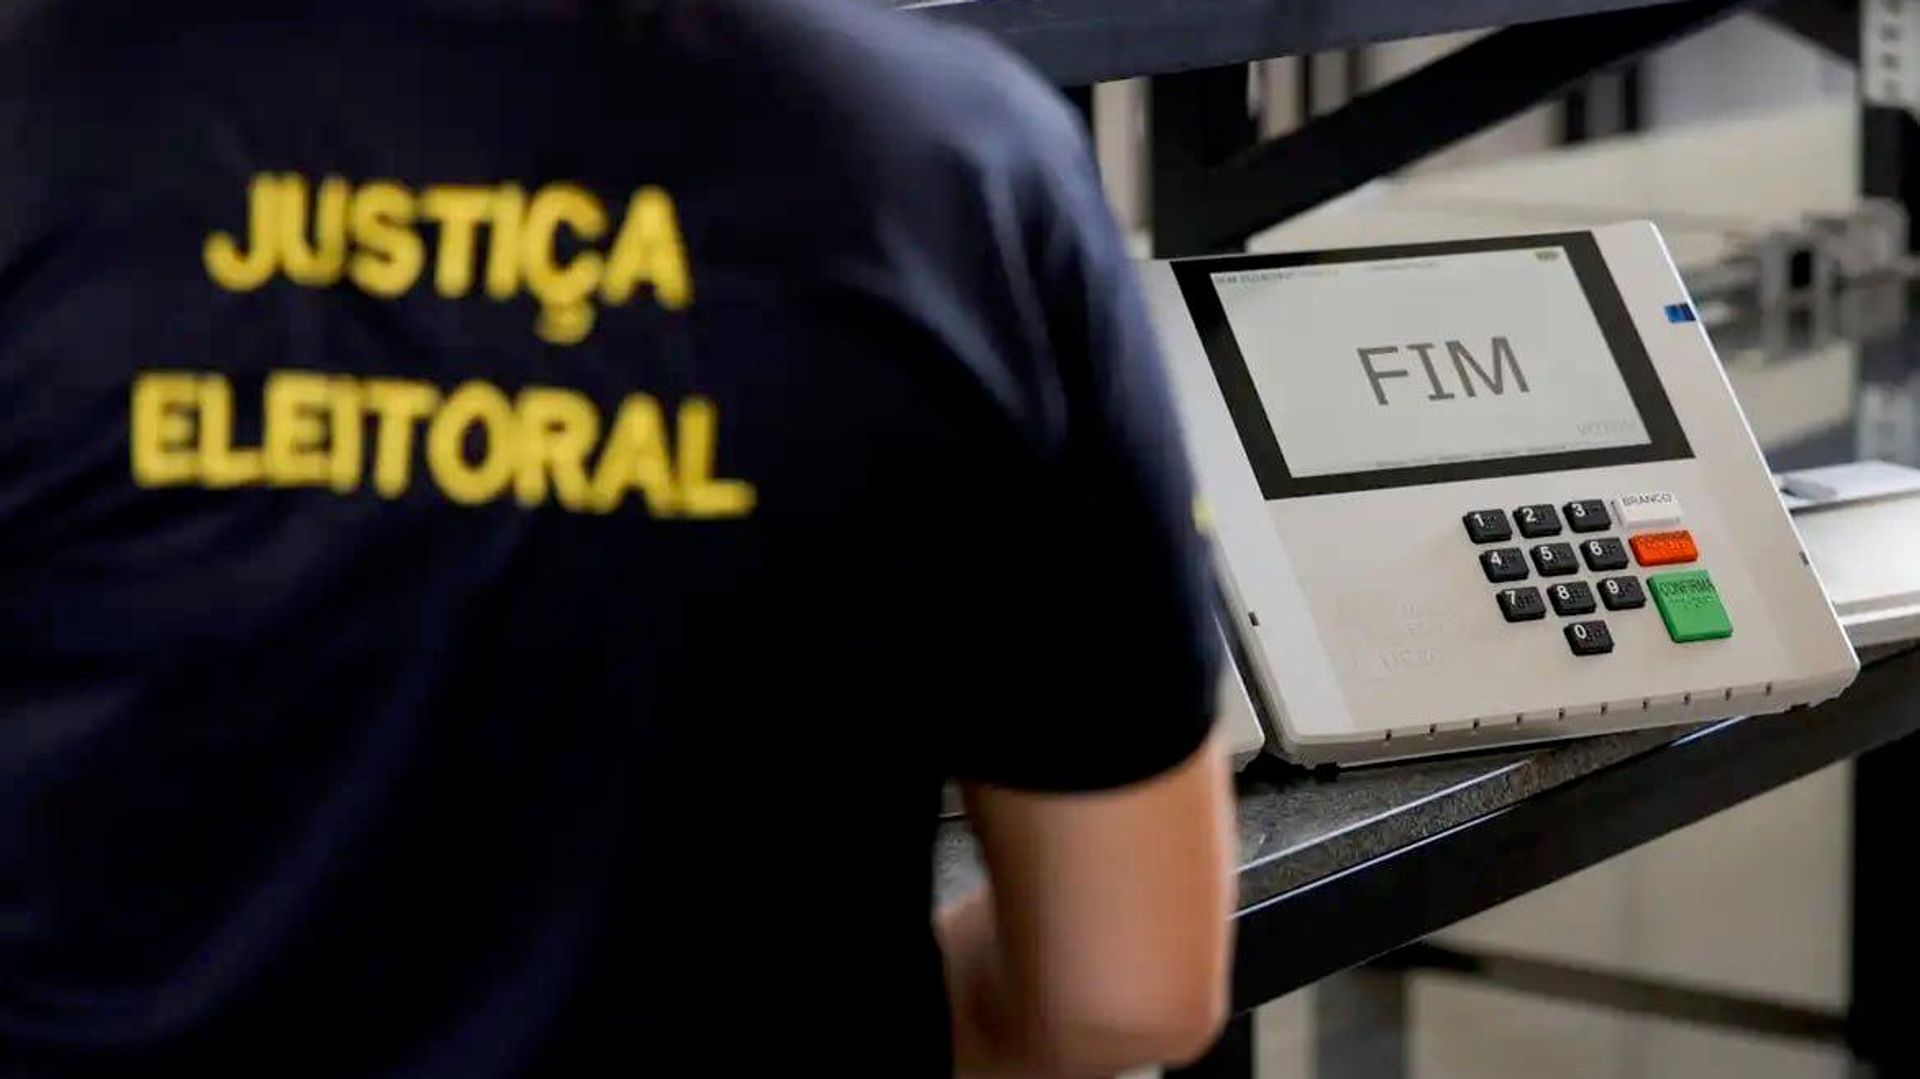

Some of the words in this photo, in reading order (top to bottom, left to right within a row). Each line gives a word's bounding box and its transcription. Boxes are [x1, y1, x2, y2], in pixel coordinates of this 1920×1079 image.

[204, 172, 693, 343] JUSTIÇA
[1357, 336, 1530, 405] FIM
[131, 371, 756, 519] ELEITORAL
[1522, 507, 1537, 523] 2
[1571, 503, 1586, 518] 3
[1473, 513, 1485, 528] 1
[1539, 546, 1553, 561] 5
[1589, 541, 1603, 556] 6
[1490, 551, 1502, 566] 4
[1557, 585, 1570, 600] 8
[1606, 579, 1620, 594] 9
[1504, 590, 1517, 605] 7
[1573, 623, 1587, 639] 0
